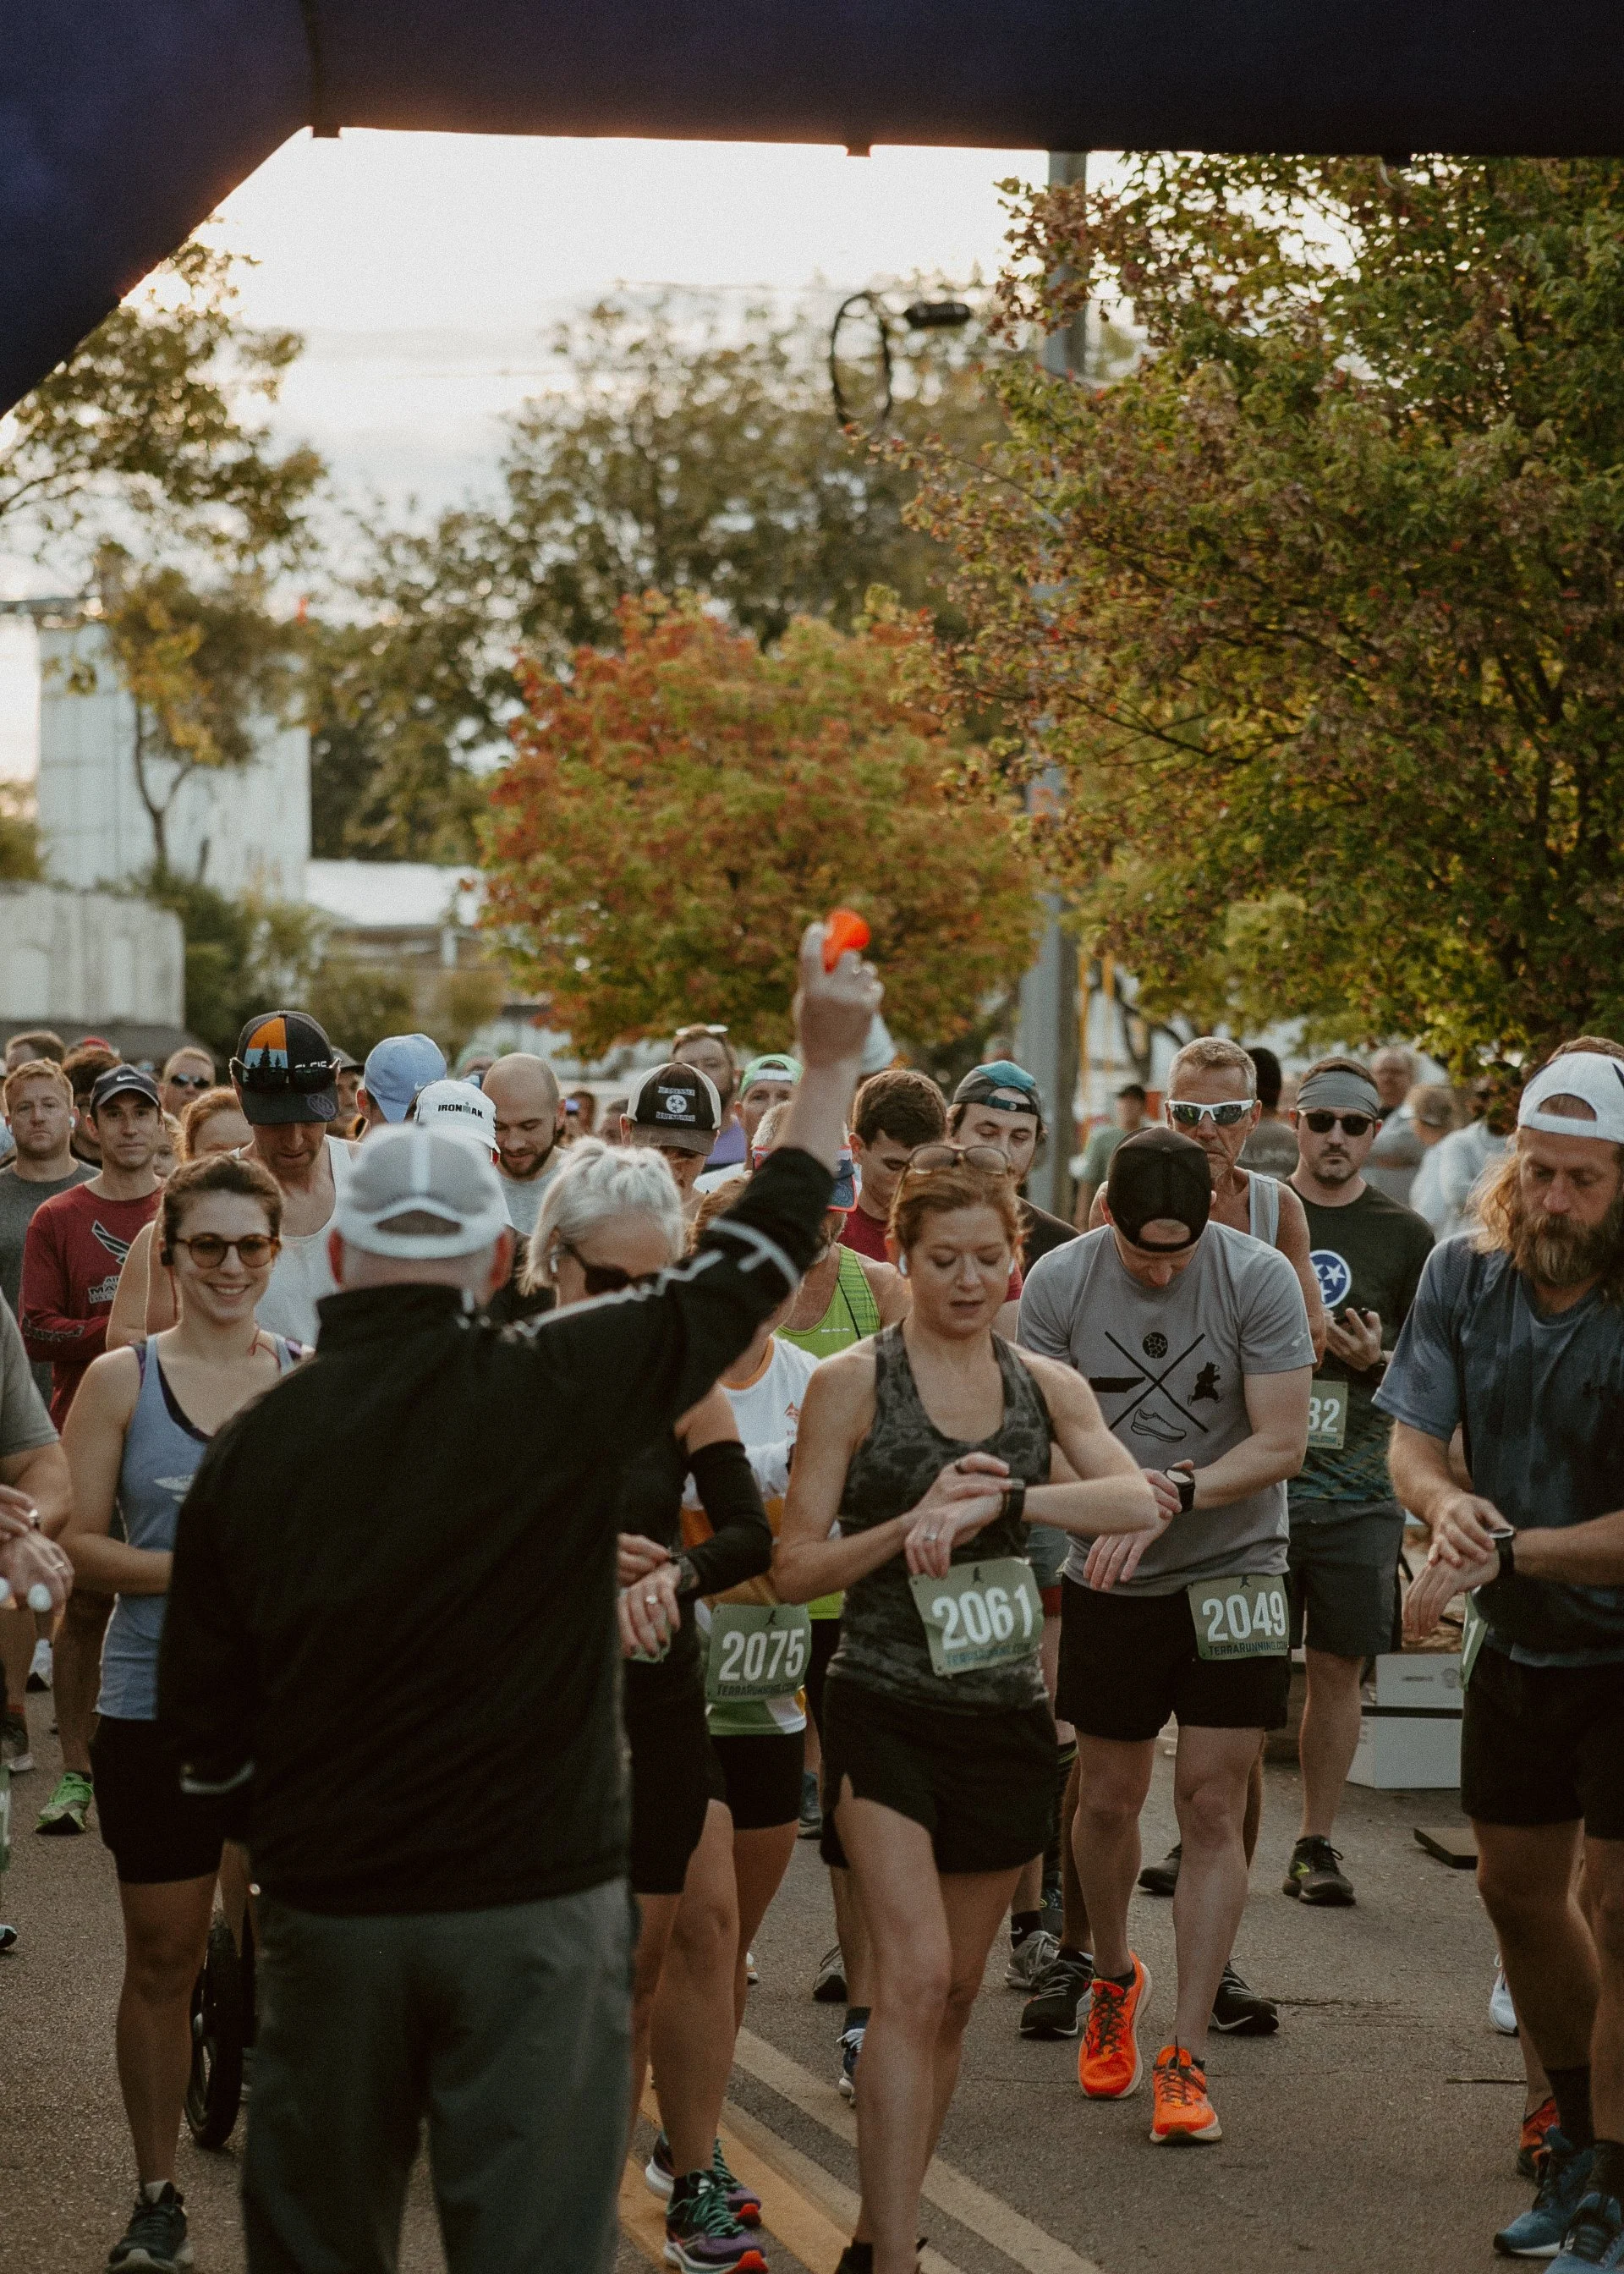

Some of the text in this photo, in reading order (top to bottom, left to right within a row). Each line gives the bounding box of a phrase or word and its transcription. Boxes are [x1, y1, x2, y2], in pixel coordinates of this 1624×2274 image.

[437, 1101, 484, 1119] IRONMAN
[932, 1585, 1033, 1651] 2061
[1202, 1591, 1286, 1643] 2049
[718, 1629, 804, 1681] 2075
